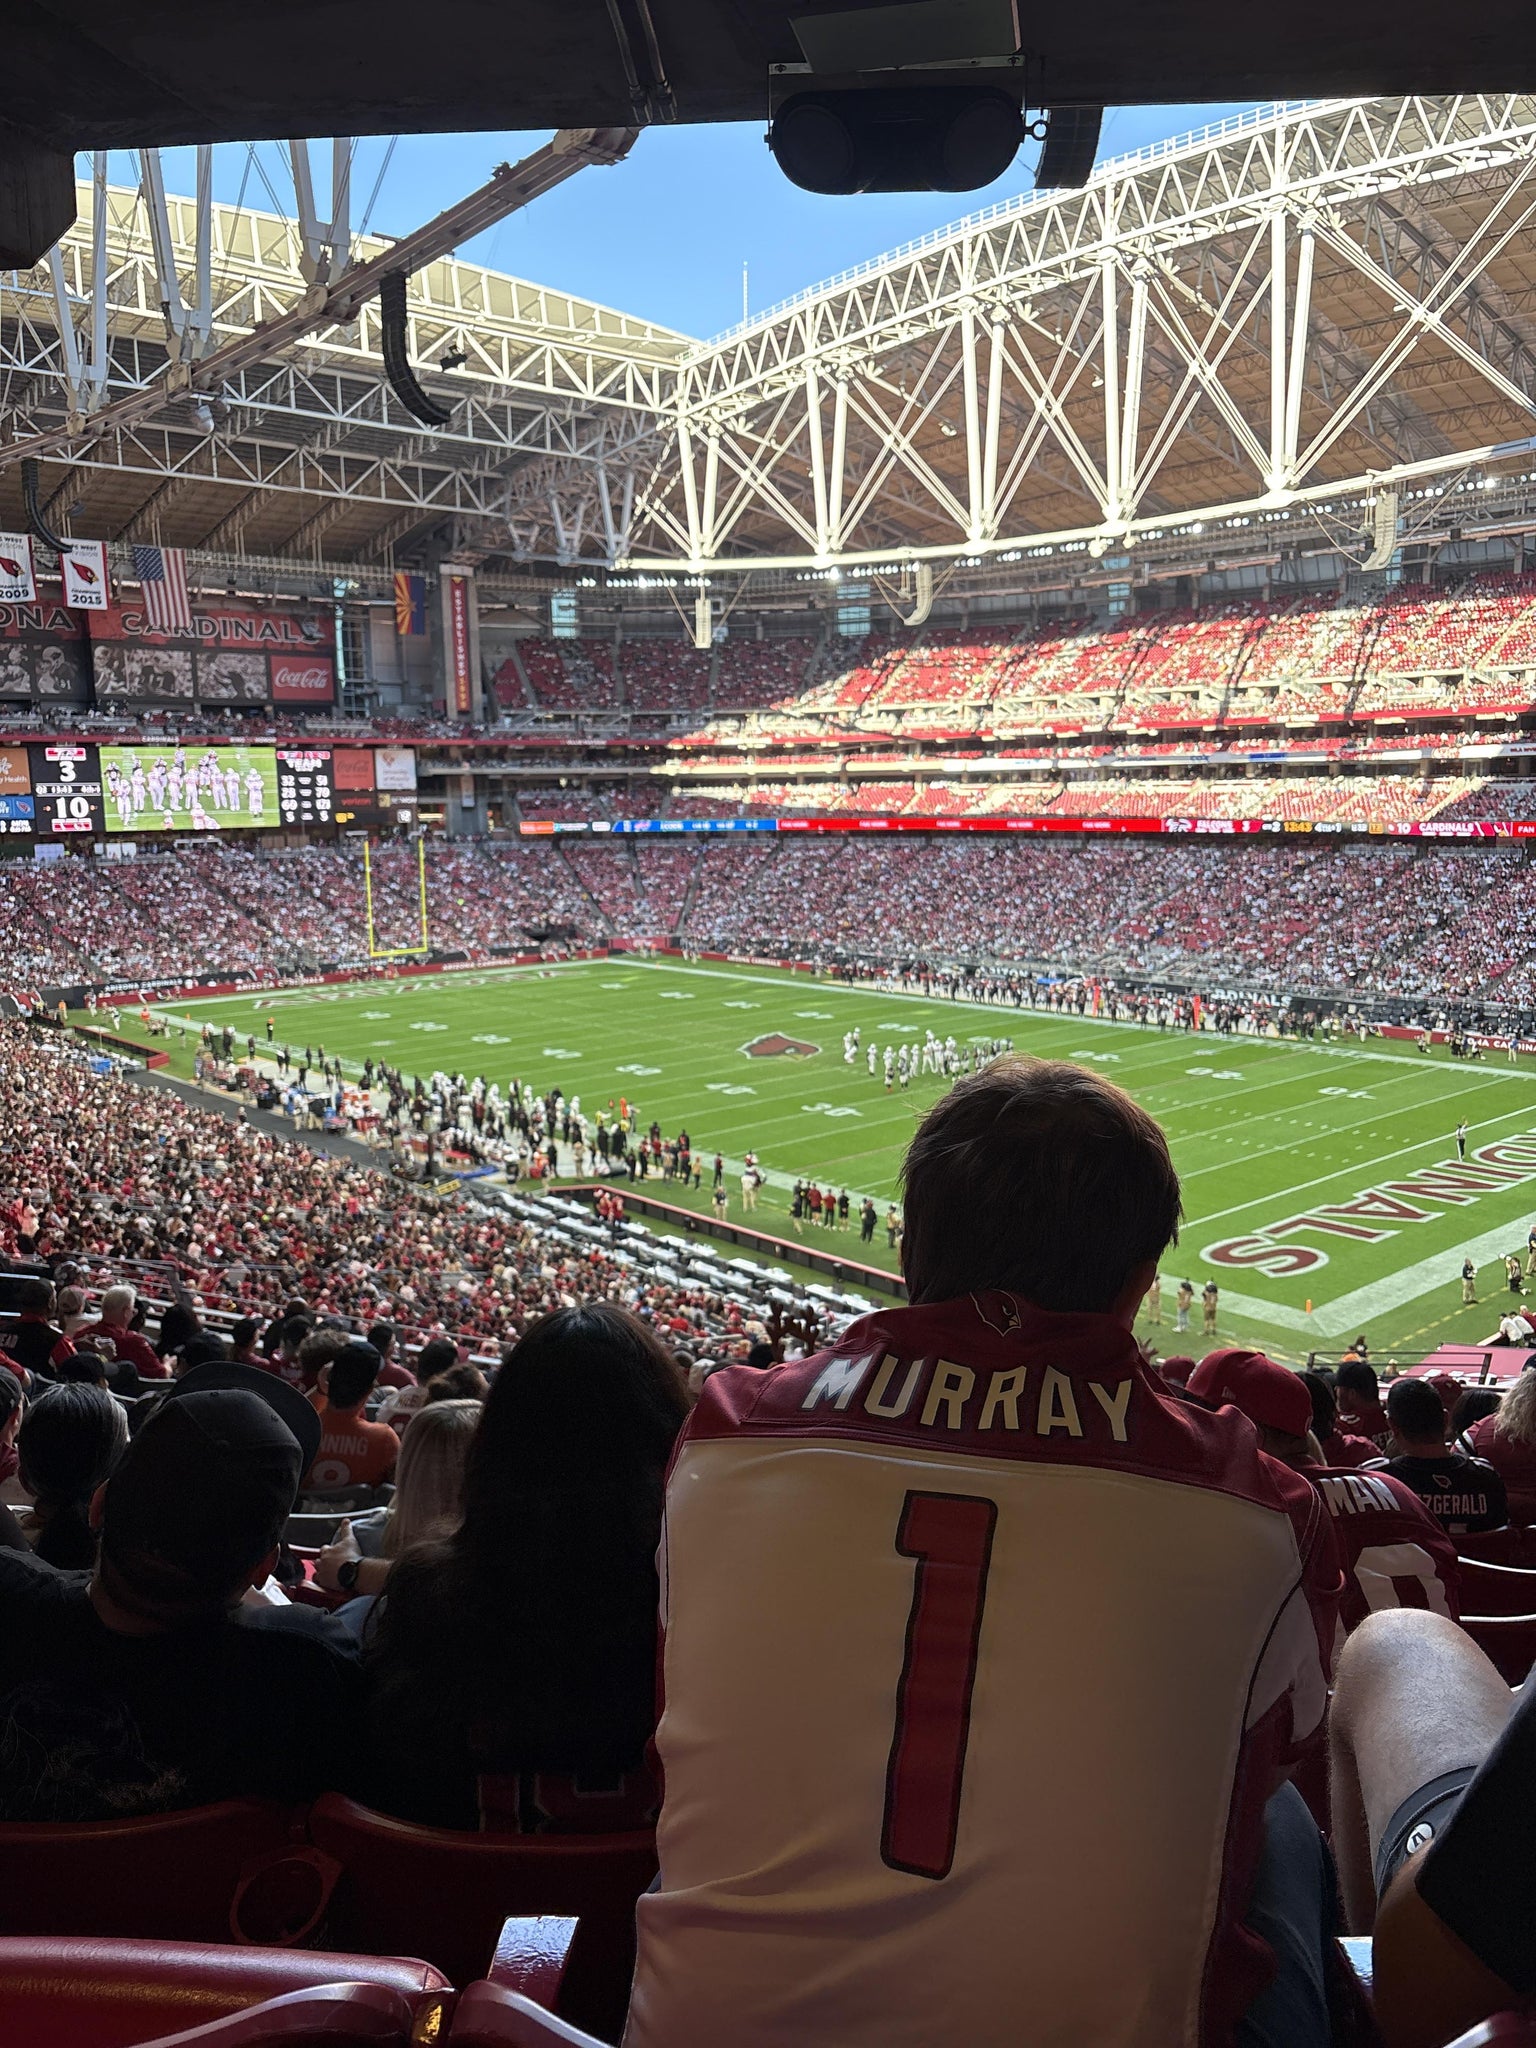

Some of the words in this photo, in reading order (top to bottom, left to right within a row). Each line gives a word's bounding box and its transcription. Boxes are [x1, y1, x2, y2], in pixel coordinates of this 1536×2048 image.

[0, 588, 30, 600] 2009
[72, 593, 103, 606] 2015
[59, 760, 76, 782] 3
[56, 796, 89, 819] 10
[1396, 822, 1411, 834] 10
[1419, 822, 1475, 832] CARDINALS
[1518, 825, 1535, 834] FAN
[1199, 1127, 1536, 1279] DINALS
[803, 1354, 1134, 1442] MURRAY
[1318, 1475, 1401, 1517] MAN
[1419, 1493, 1488, 1516] ZGERALD
[880, 1489, 998, 1881] 1
